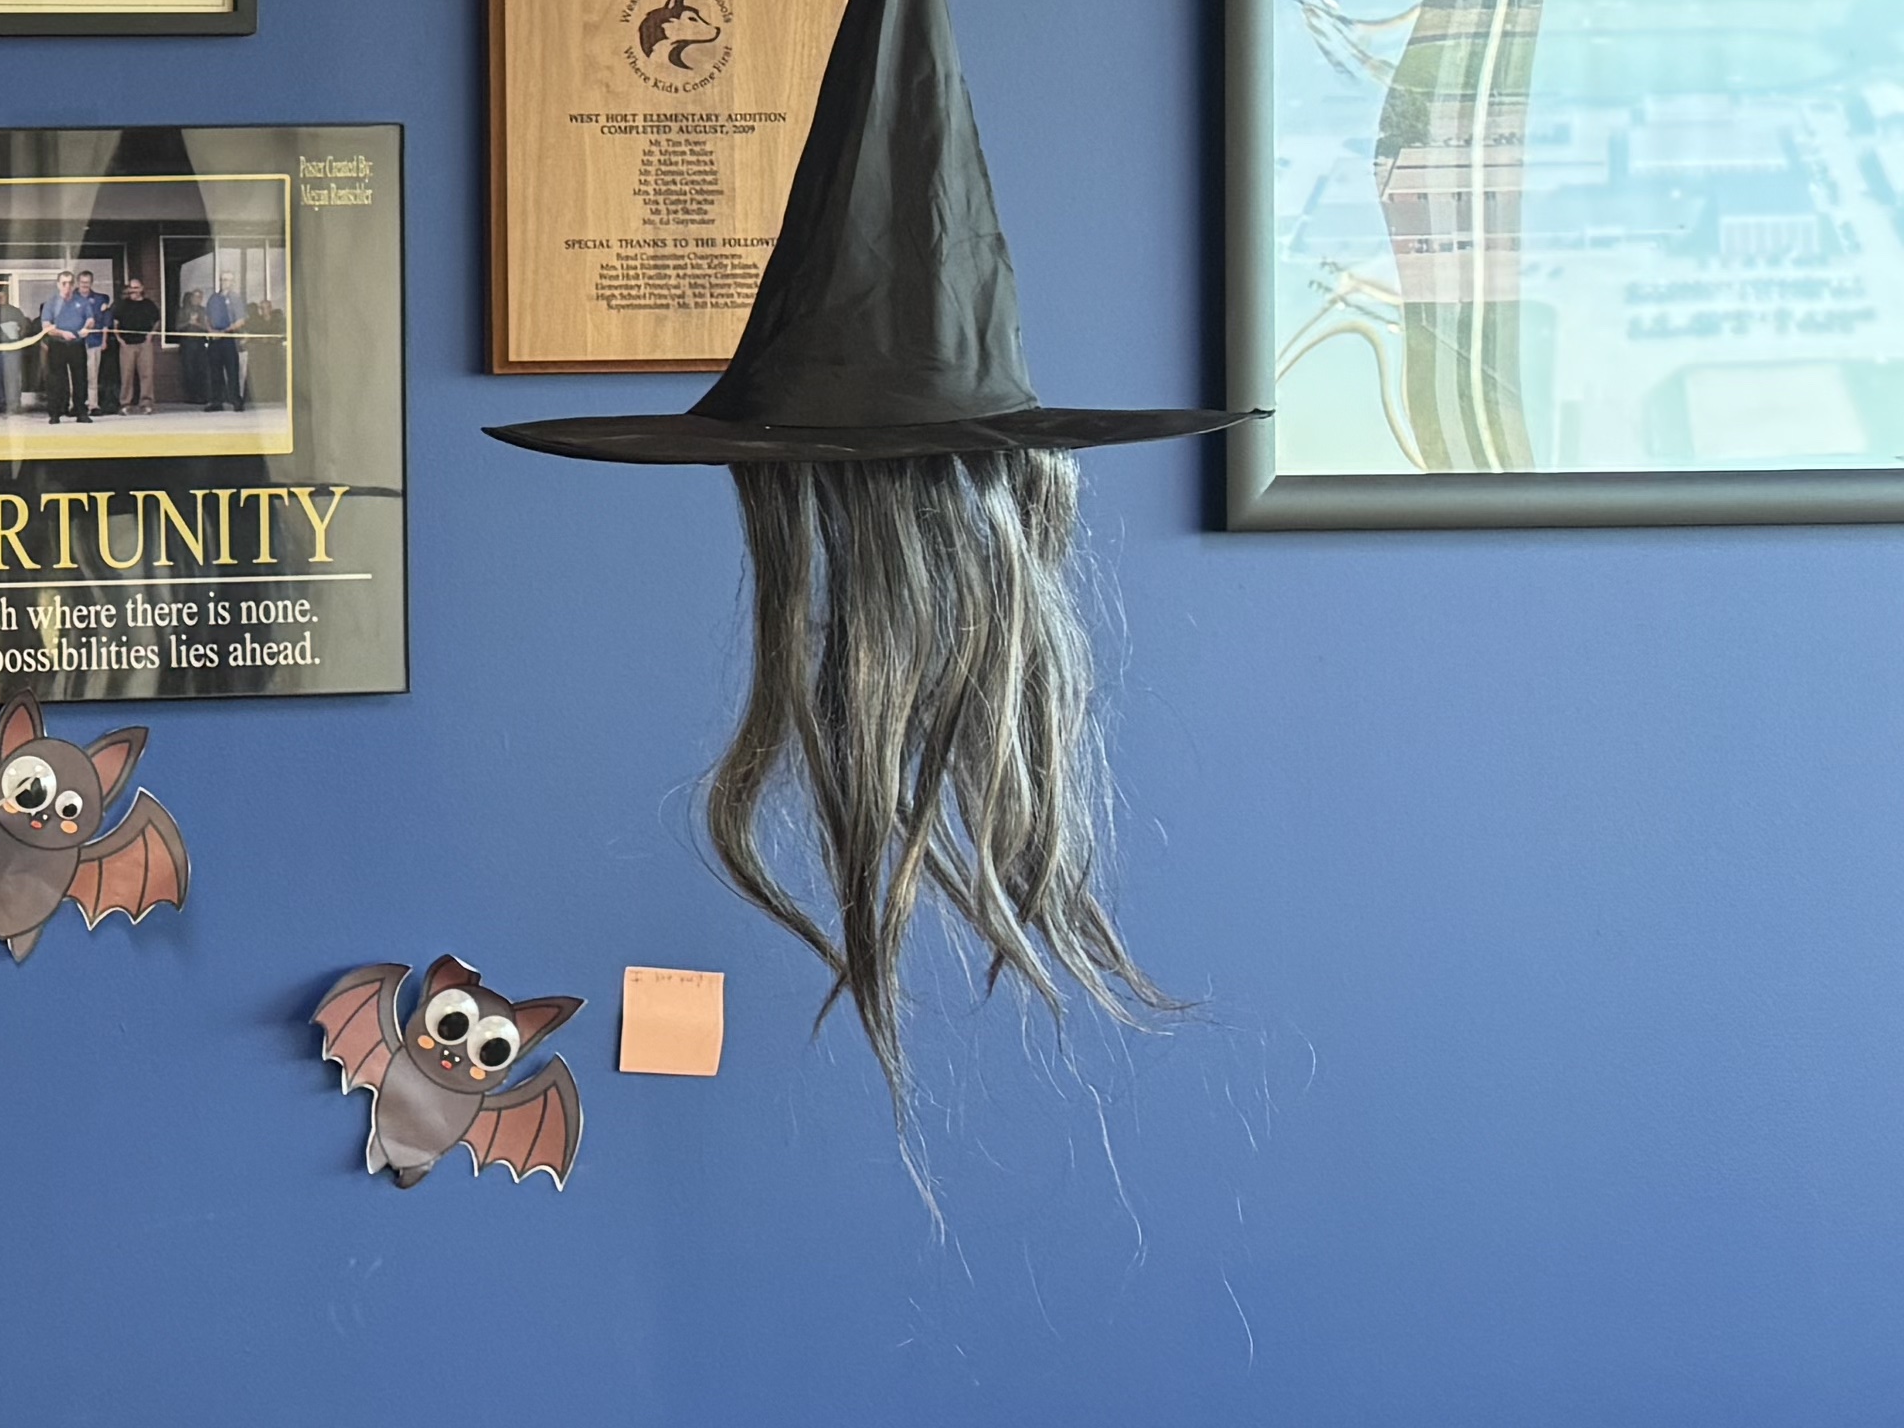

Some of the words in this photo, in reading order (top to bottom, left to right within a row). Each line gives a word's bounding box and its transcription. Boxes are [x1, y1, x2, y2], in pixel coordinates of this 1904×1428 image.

[622, 46, 651, 84] Where
[651, 79, 679, 94] Kids
[682, 72, 716, 94] Come
[713, 45, 733, 74] First
[569, 114, 601, 124] WEST
[605, 114, 638, 124] HOLT
[643, 113, 720, 123] ELEMENTARY
[726, 112, 787, 122] ADDITION
[600, 125, 672, 136] COMPLETED
[676, 124, 729, 135] AUGUST,
[732, 124, 756, 135] 2009
[299, 156, 325, 178] Poster
[325, 155, 357, 177] Created
[300, 184, 329, 211] Megan
[564, 239, 612, 250] SPECIAL
[618, 238, 667, 249] THANKS
[673, 238, 688, 249] TO
[694, 238, 717, 249] THE
[27, 598, 117, 630] where
[125, 596, 198, 628] there
[207, 596, 231, 625] is
[240, 597, 318, 624] none.
[169, 634, 218, 666] lies
[228, 633, 321, 667] ahead.
